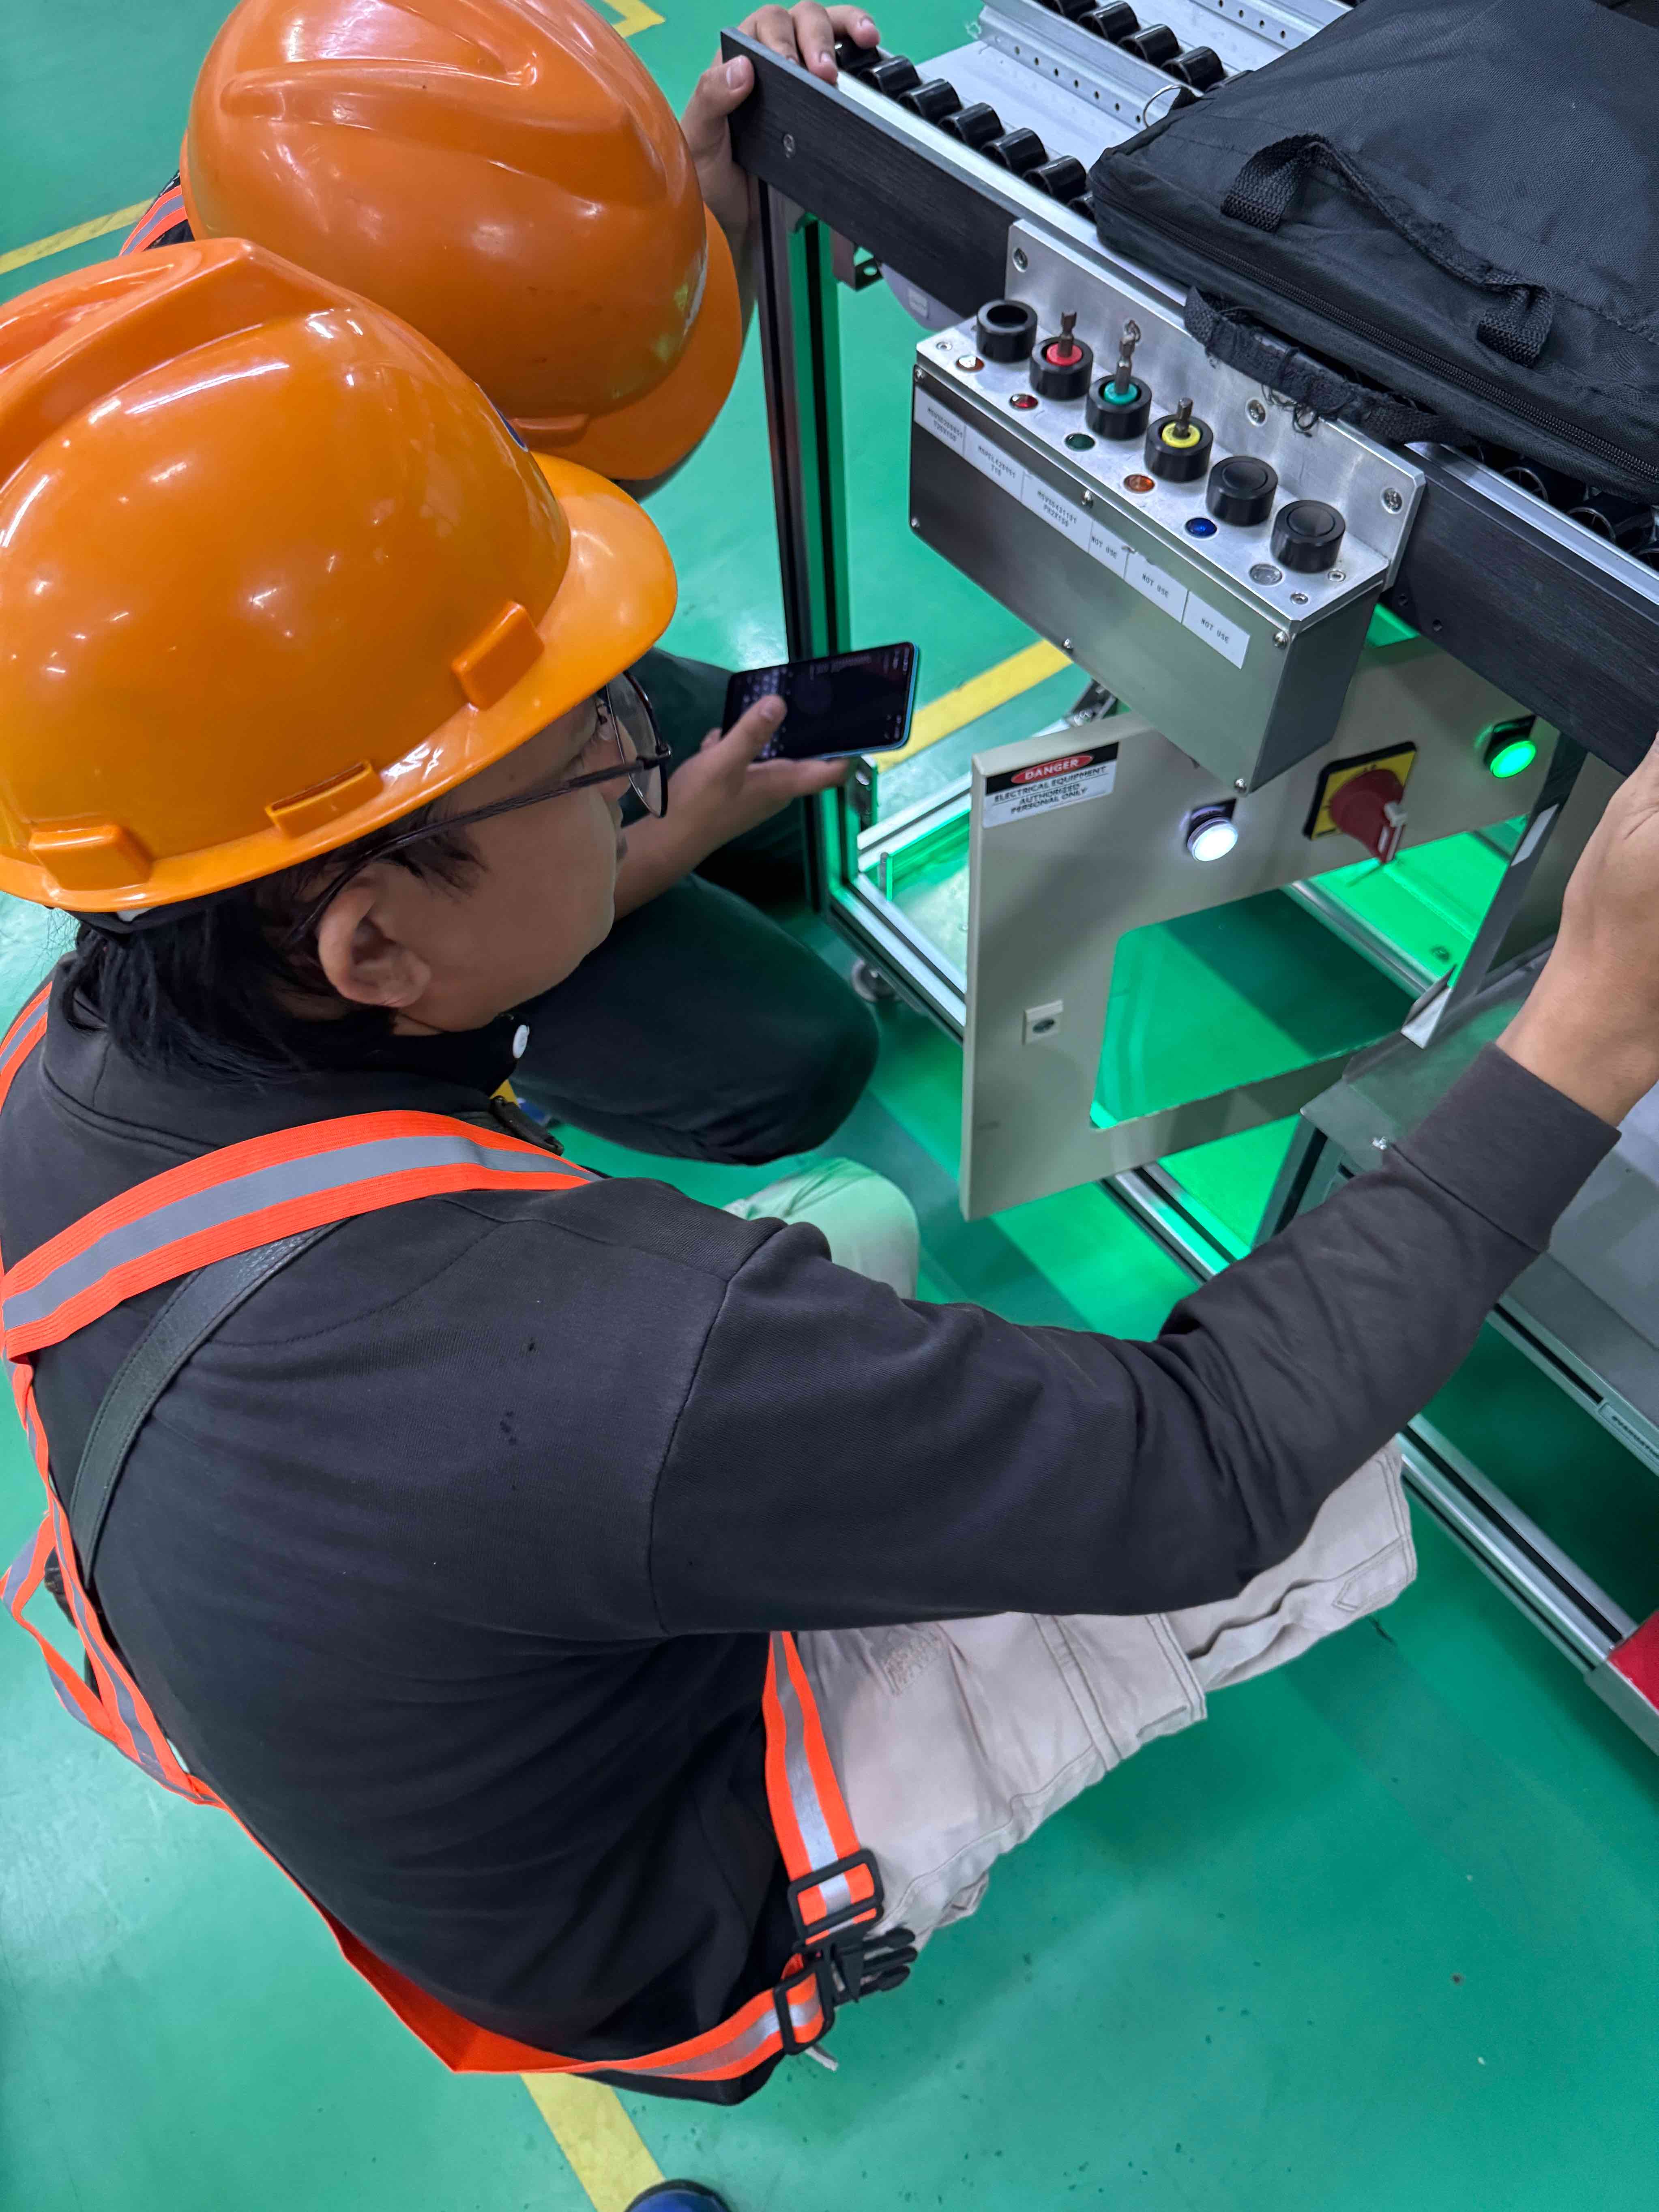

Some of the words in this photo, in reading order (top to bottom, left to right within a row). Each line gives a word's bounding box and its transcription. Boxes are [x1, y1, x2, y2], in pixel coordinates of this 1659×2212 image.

[1091, 535, 1103, 548] NOT
[1106, 546, 1117, 559] USE
[1142, 574, 1154, 586] NOT
[1157, 585, 1169, 598] USE
[1201, 618, 1214, 631] NOT
[1217, 630, 1230, 644] USE
[1025, 758, 1080, 781] DANGER
[994, 782, 1049, 802] ELECTRICAL
[1052, 766, 1107, 786] EQUIPMENT
[1019, 784, 1080, 804] AUTHORIZED
[1011, 797, 1059, 814] PERSONAL
[1062, 787, 1087, 800] ONLY
